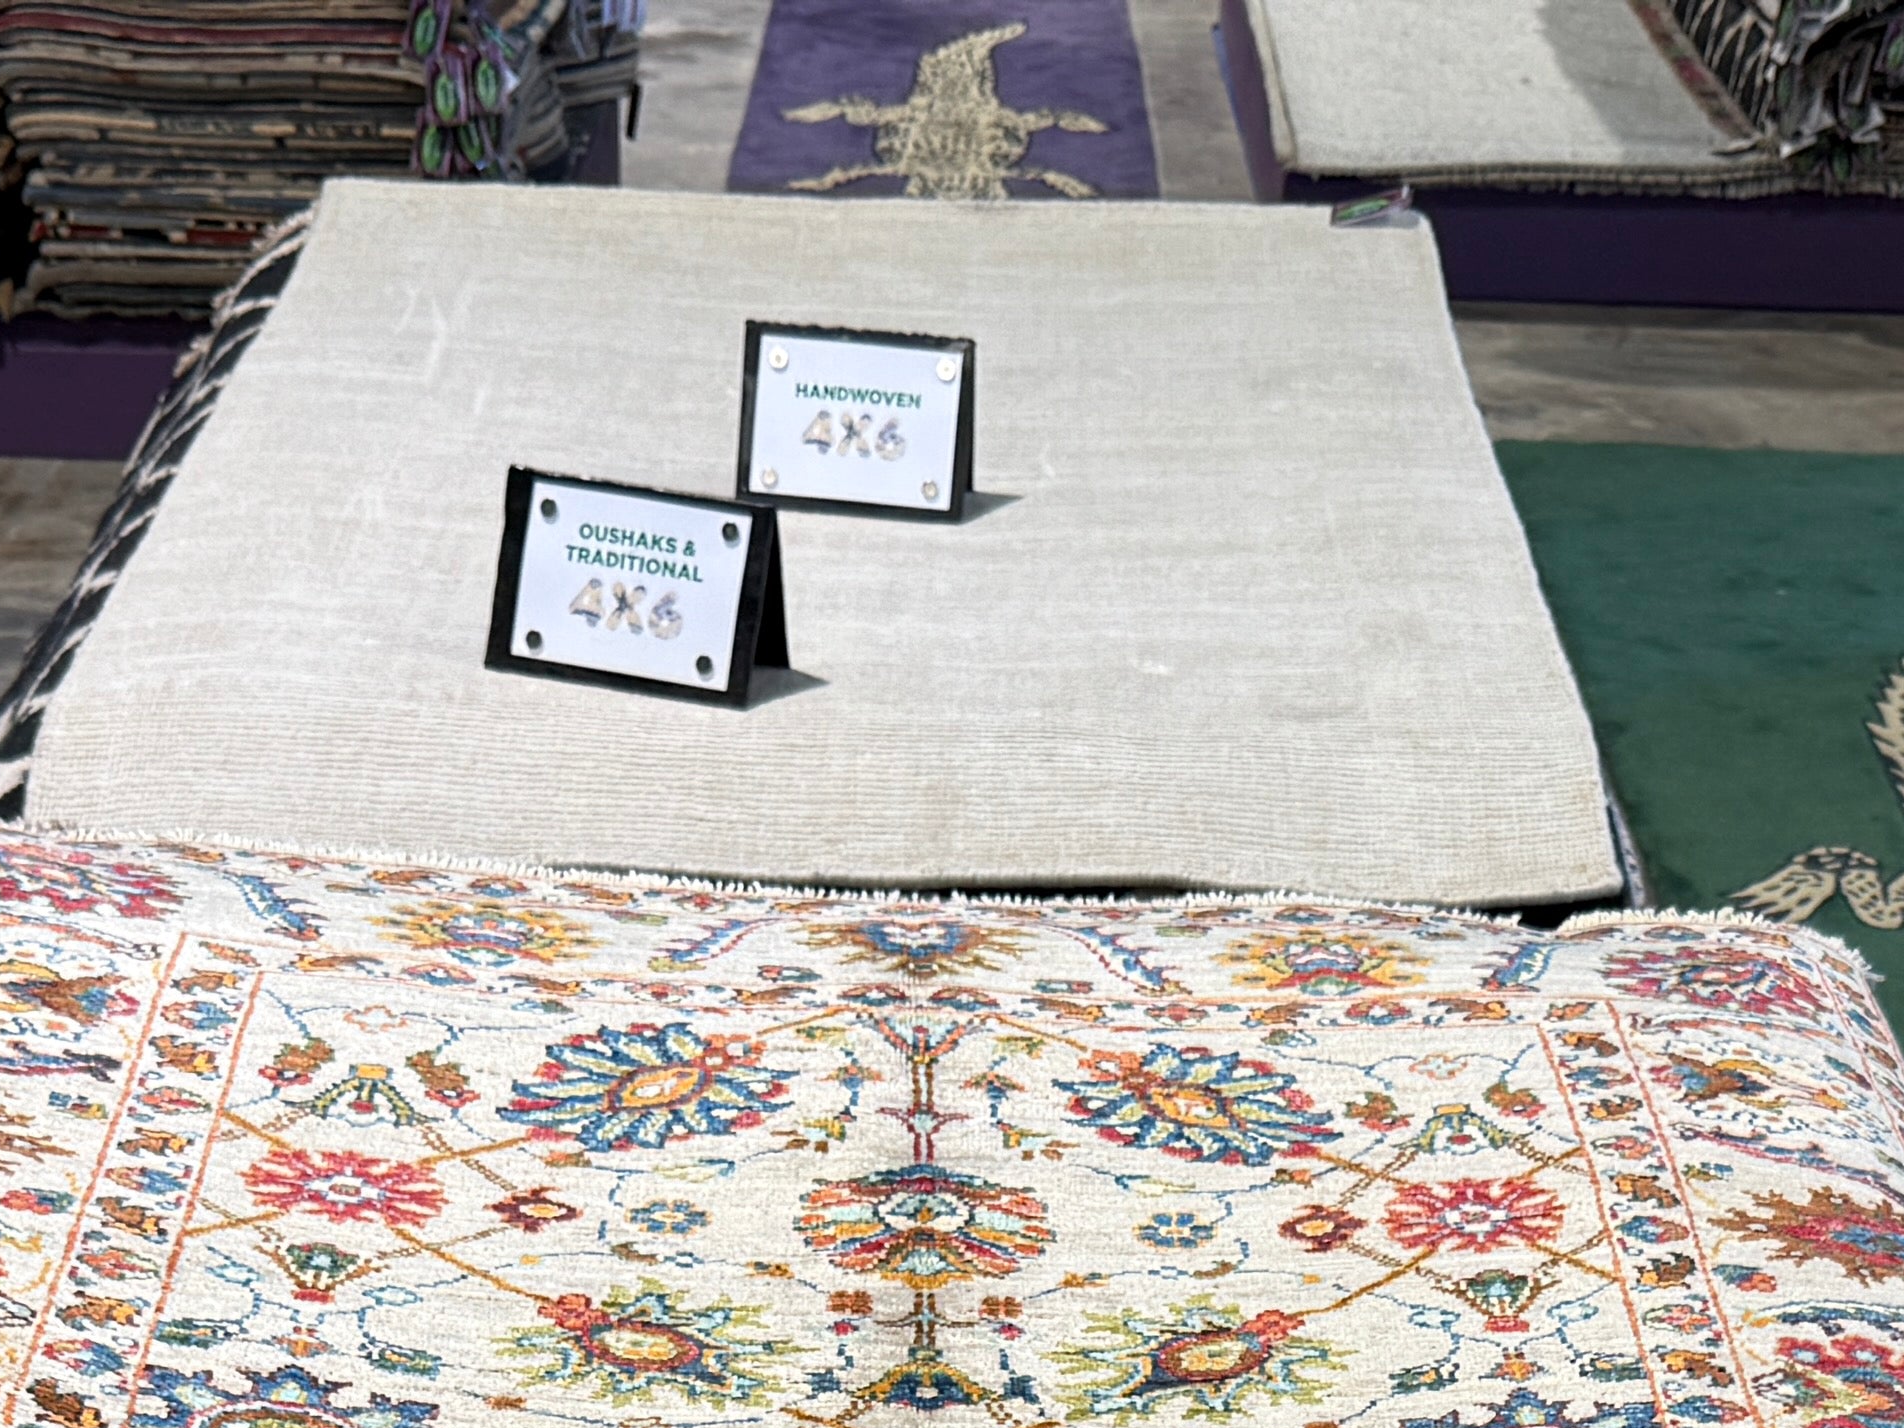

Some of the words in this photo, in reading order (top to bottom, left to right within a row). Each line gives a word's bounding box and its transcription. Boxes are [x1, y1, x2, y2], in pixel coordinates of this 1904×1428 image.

[794, 382, 923, 409] HANDWOVEN
[801, 410, 907, 462] 4X6
[578, 523, 679, 555] OUSHAKS
[682, 539, 697, 558] &
[565, 544, 704, 583] TRADITIONAL
[568, 577, 684, 641] 4X6
